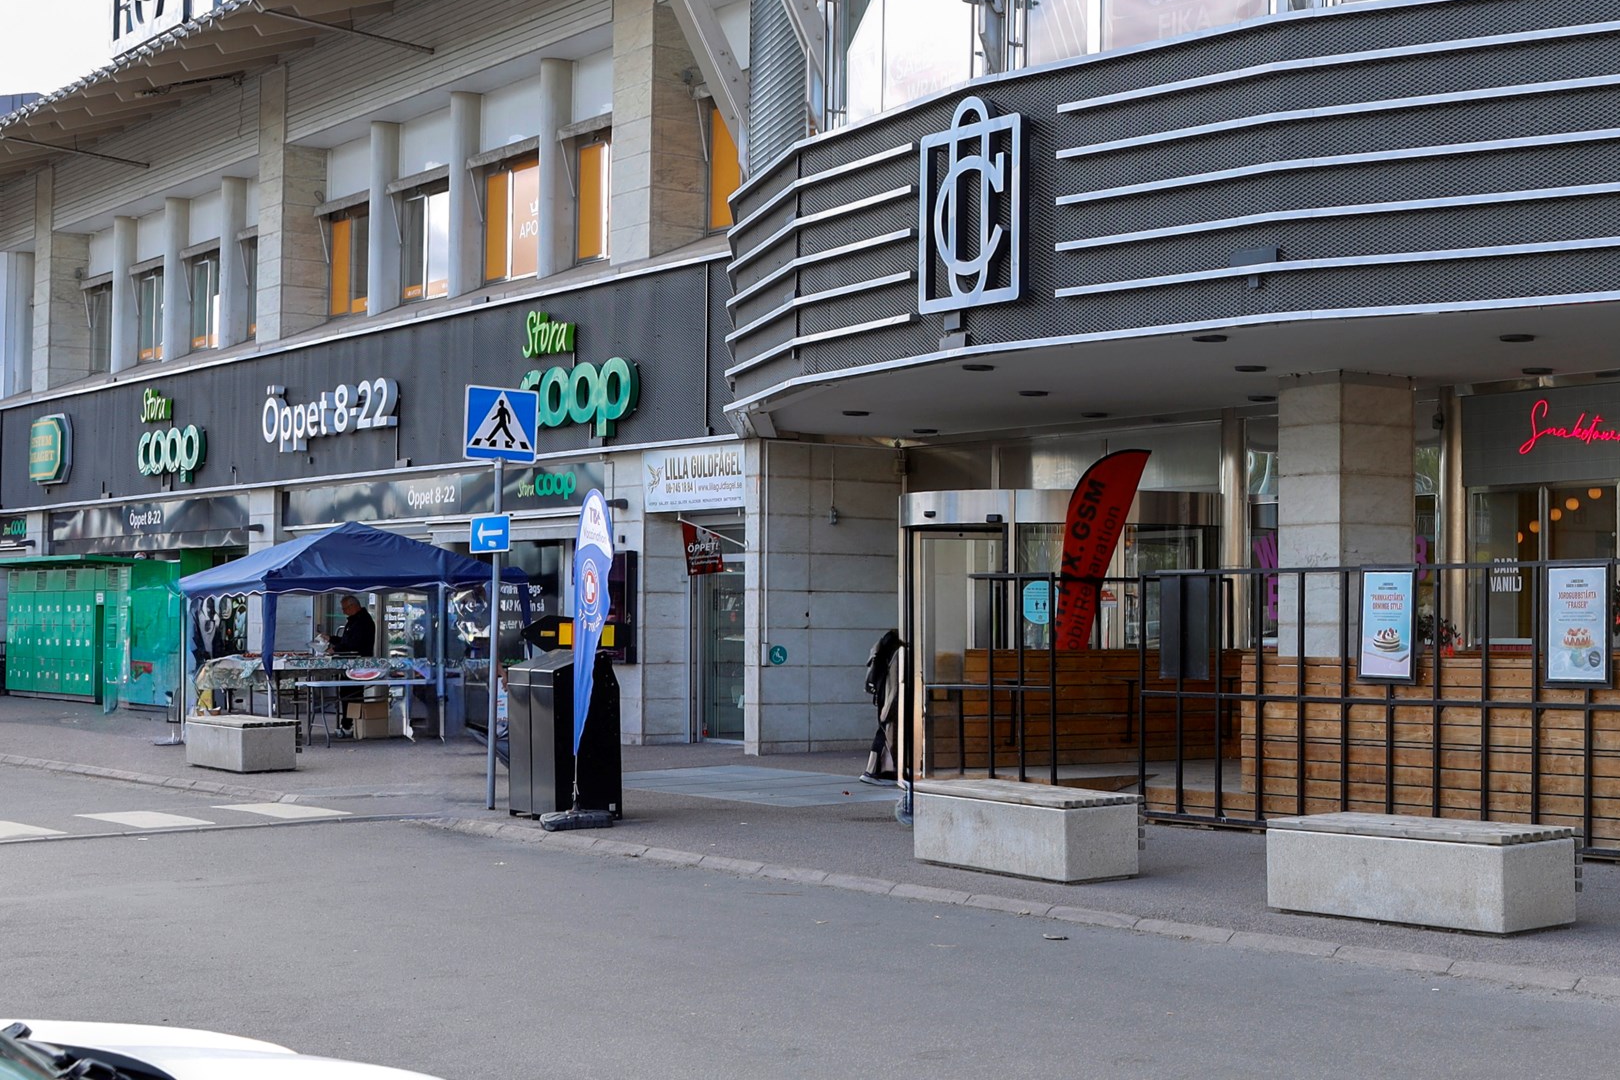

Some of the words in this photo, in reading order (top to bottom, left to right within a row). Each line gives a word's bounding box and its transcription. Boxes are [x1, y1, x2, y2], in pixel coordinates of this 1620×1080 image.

[1158, 4, 1212, 39] FIKA
[522, 310, 568, 358] Stora
[141, 388, 168, 423] Stora
[262, 385, 328, 452] Öppet
[334, 377, 392, 432] 8-22
[138, 424, 202, 484] coop
[665, 456, 689, 480] LILLA
[691, 447, 742, 477] GULDFÅGEL
[408, 486, 433, 509] Öppet
[435, 485, 455, 504] 8-22
[535, 471, 576, 500] coop
[130, 510, 146, 529] Öppet
[687, 542, 719, 554] ÖPPET!
[1490, 576, 1522, 592] VANILJ
